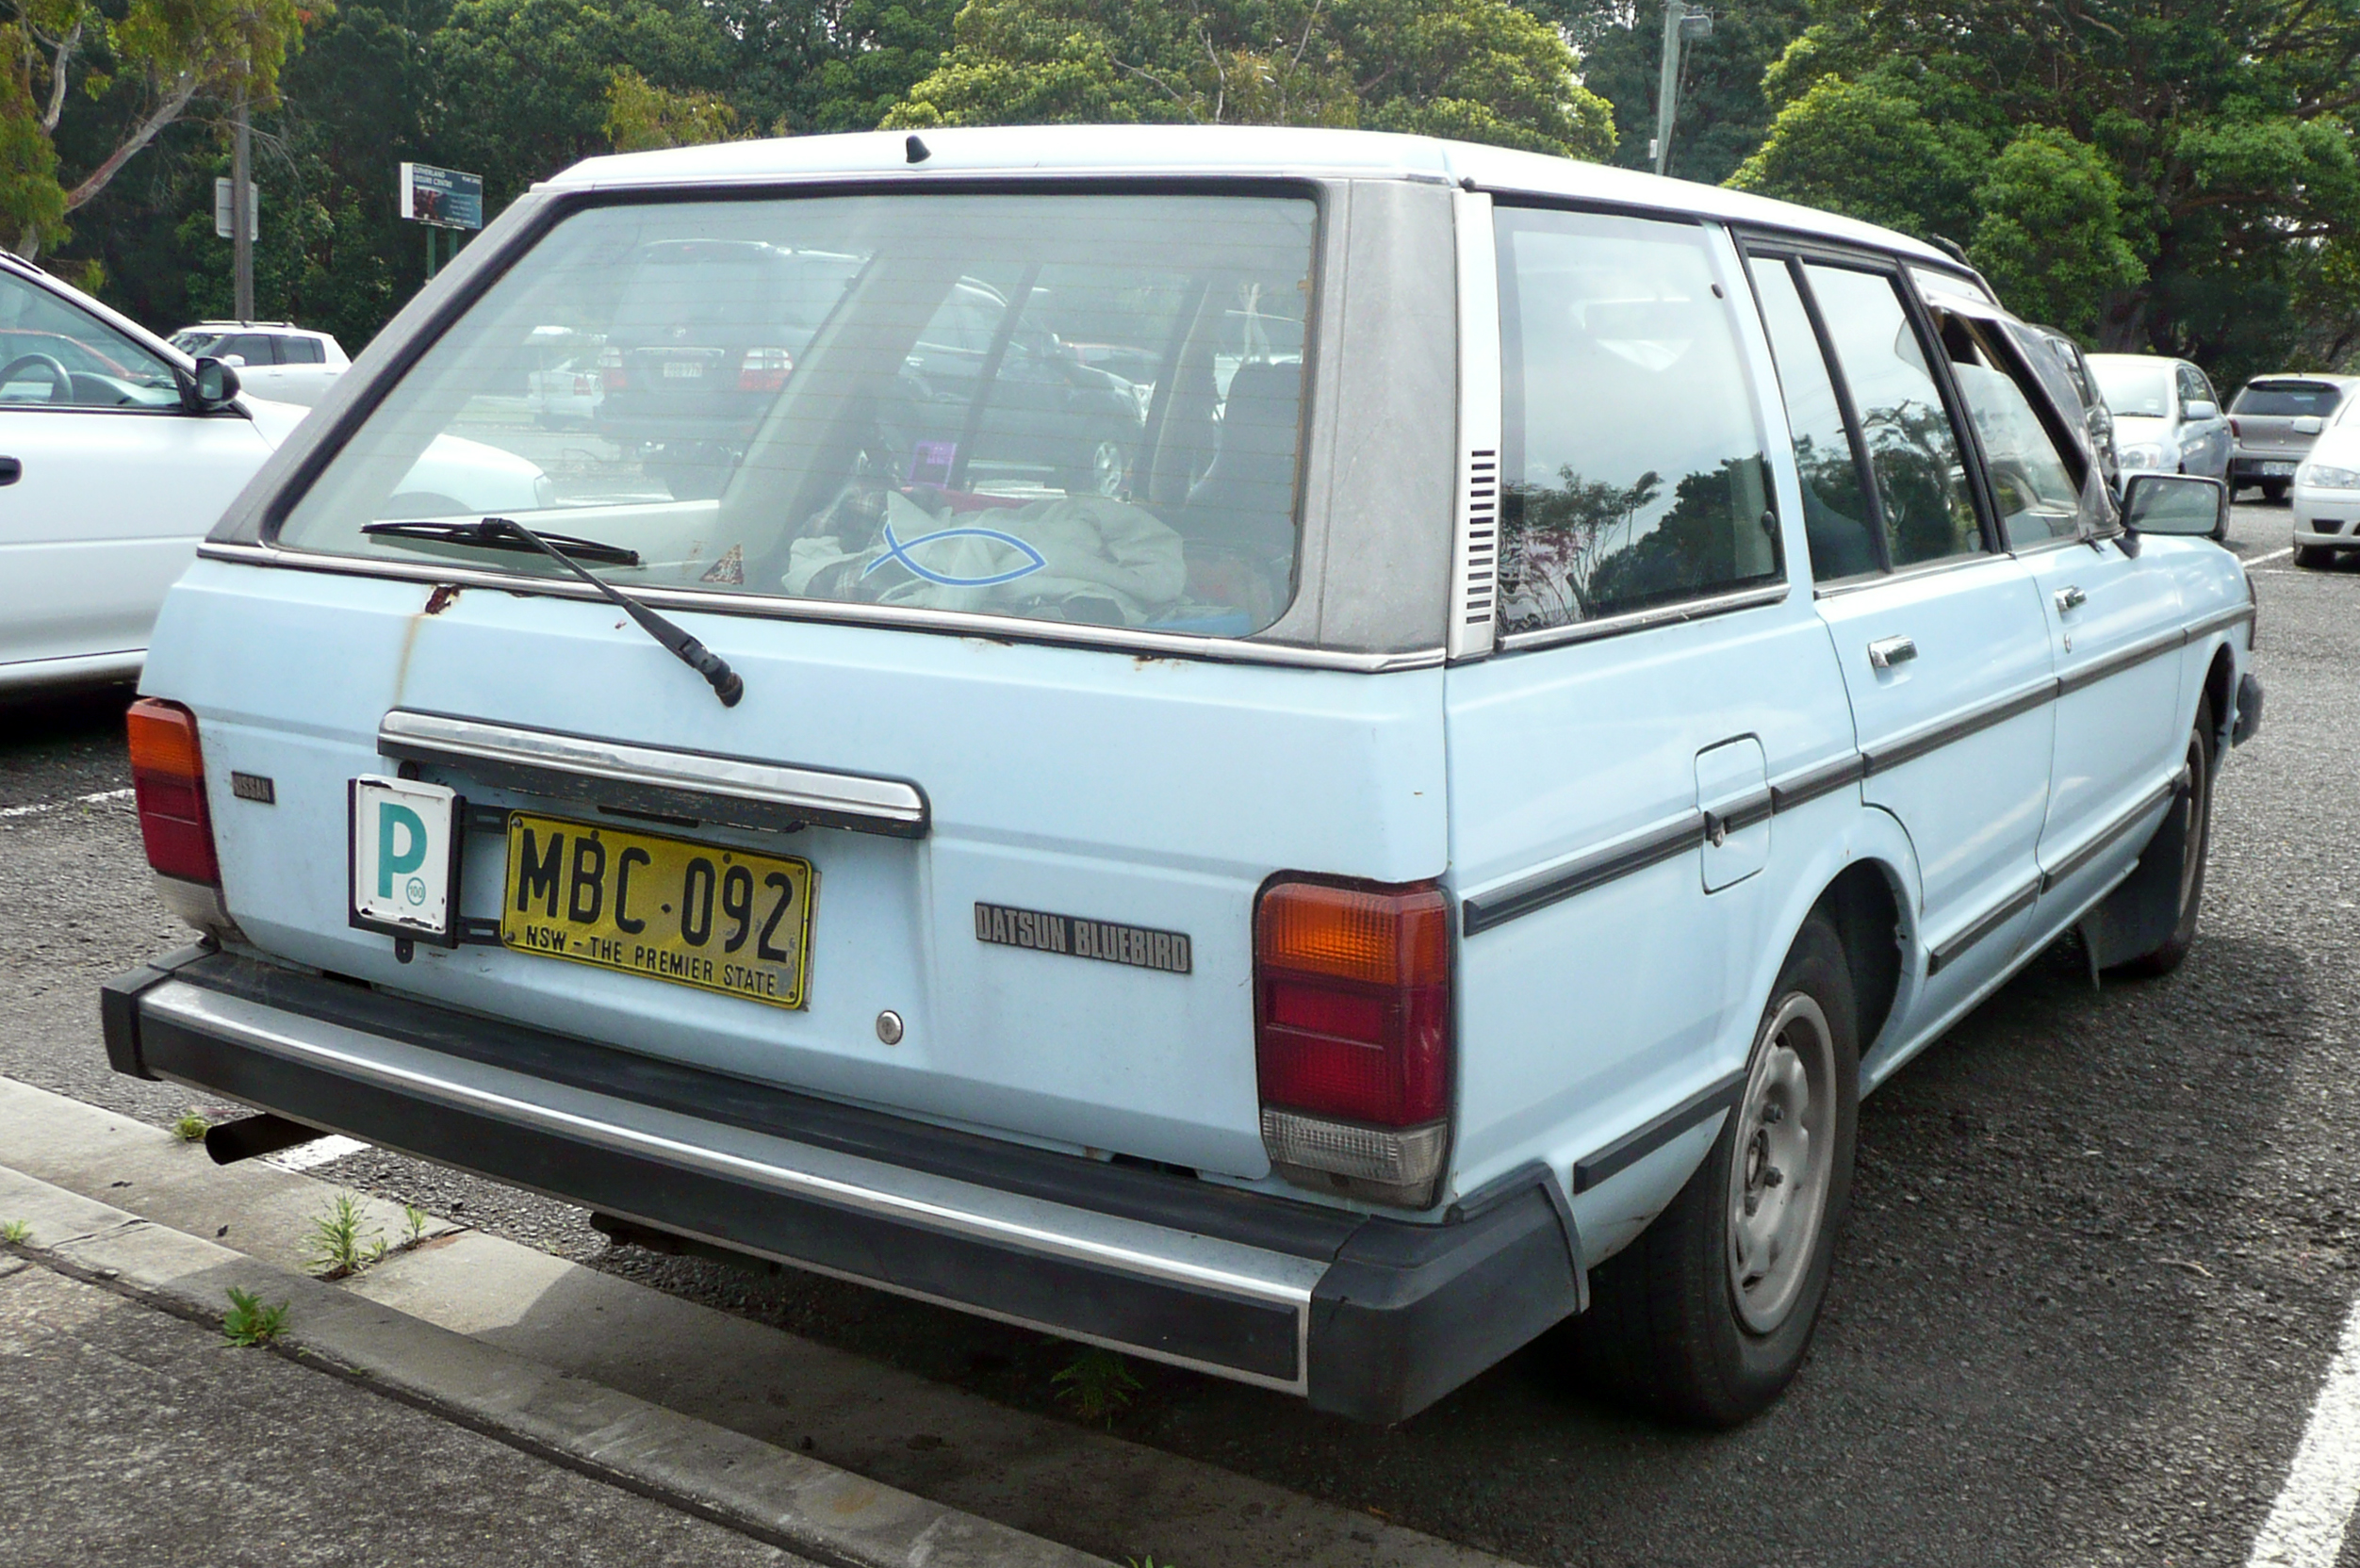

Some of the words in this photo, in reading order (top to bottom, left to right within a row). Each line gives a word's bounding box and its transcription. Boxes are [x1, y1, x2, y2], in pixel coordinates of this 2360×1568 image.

[378, 801, 427, 899] P
[409, 886, 424, 898] 100
[526, 924, 566, 952] NSW
[590, 937, 622, 962] THE
[635, 945, 713, 982] PREMIER
[724, 964, 776, 996] STATE
[975, 905, 1066, 953] DATSUN
[1074, 920, 1188, 972] BLUEBIRD
